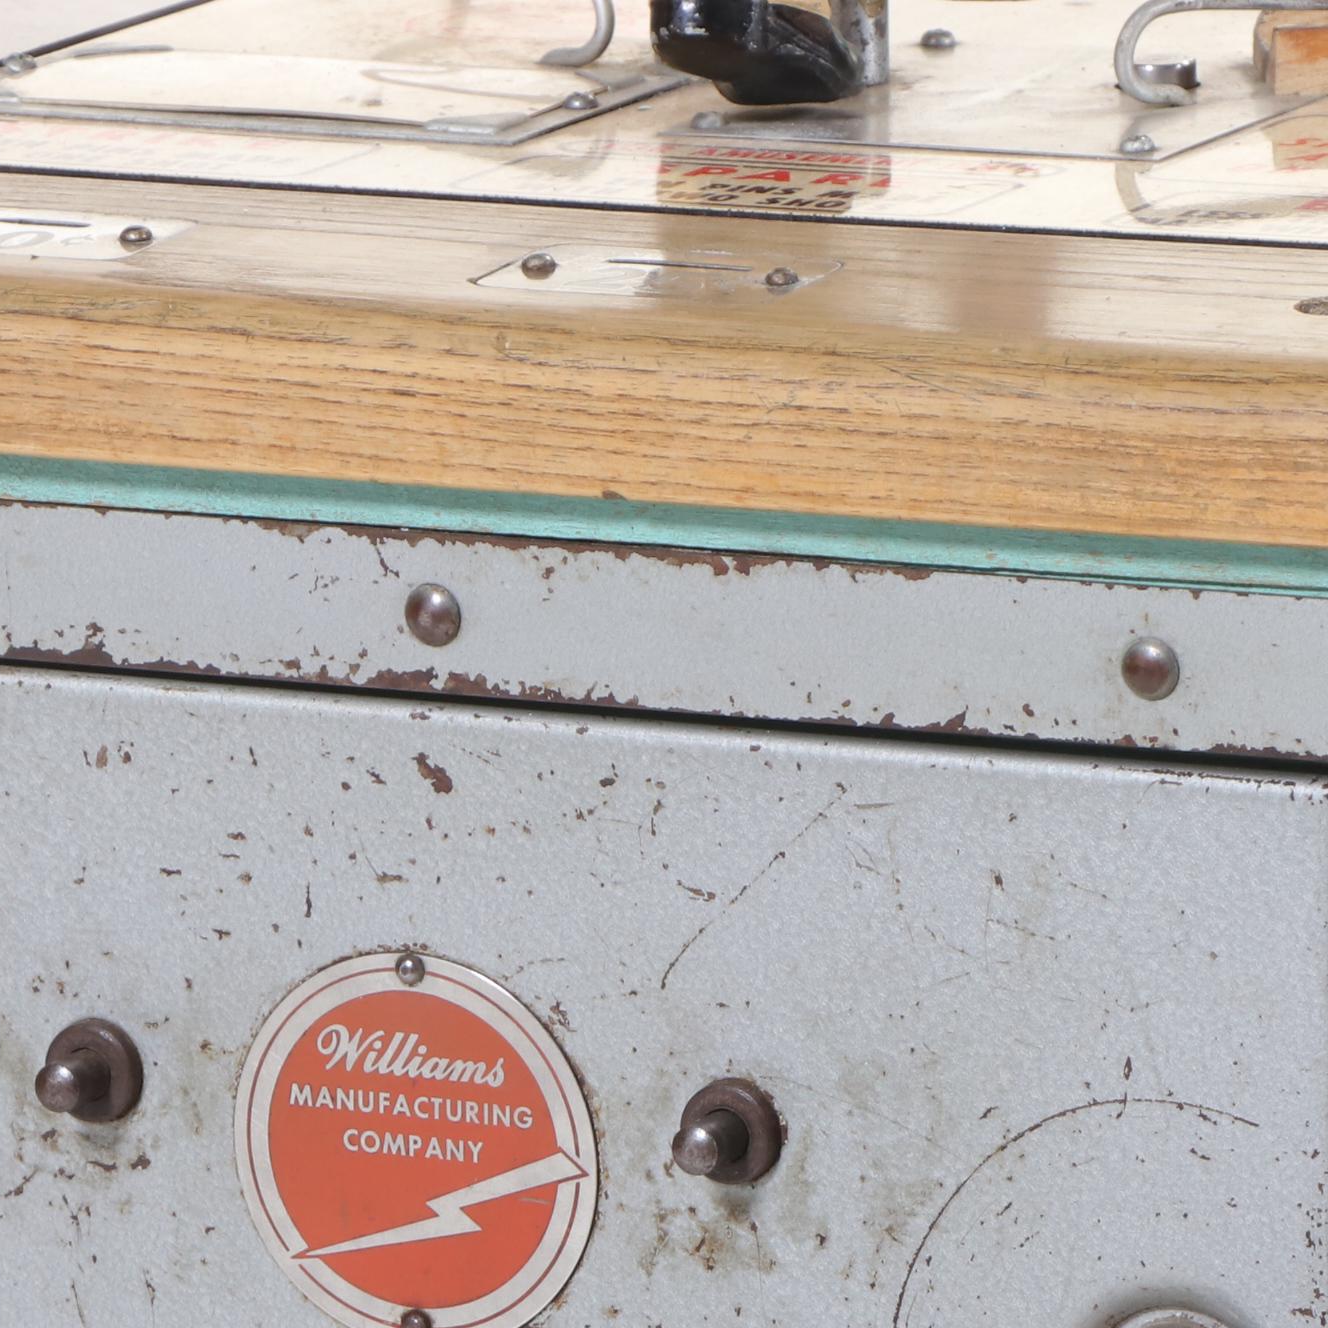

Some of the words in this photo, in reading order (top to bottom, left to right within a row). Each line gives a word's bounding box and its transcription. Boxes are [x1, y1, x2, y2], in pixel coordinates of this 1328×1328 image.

[701, 183, 803, 195] PINS
[316, 1023, 506, 1088] Williams
[289, 1083, 533, 1129] MANUFACTURING
[342, 1129, 484, 1163] COMPANY
